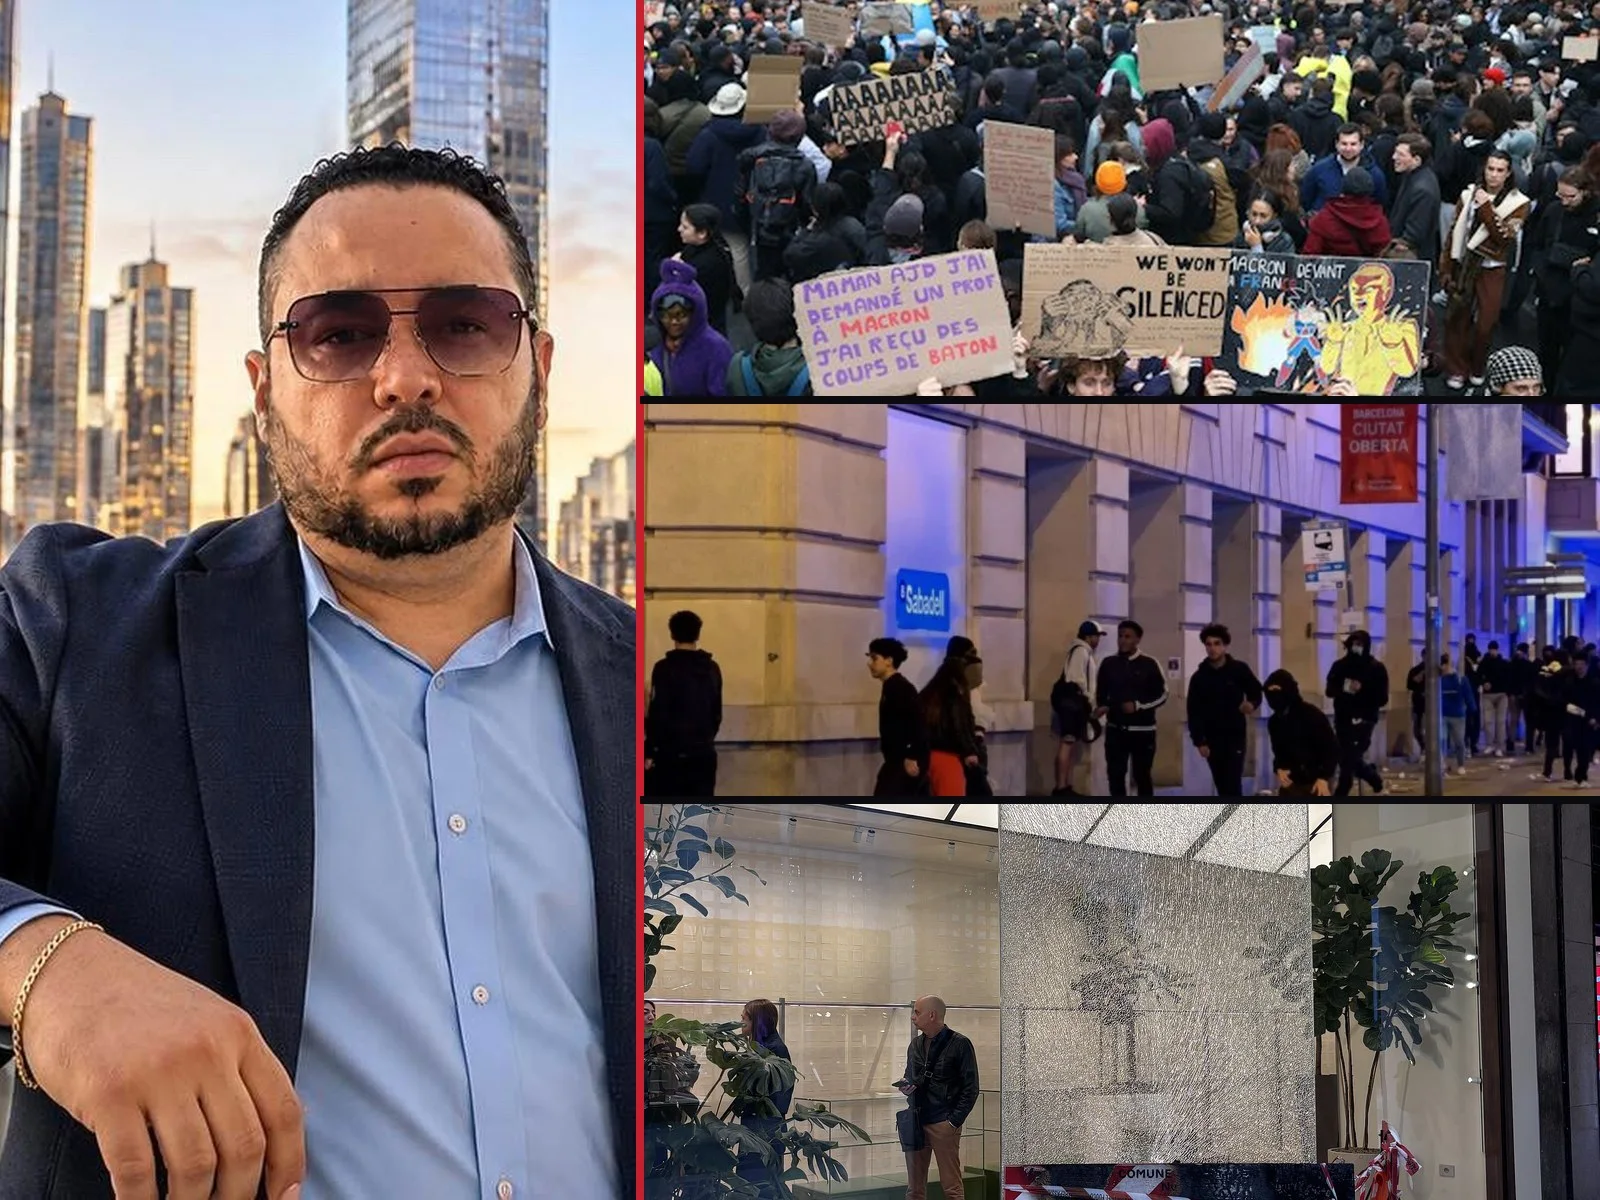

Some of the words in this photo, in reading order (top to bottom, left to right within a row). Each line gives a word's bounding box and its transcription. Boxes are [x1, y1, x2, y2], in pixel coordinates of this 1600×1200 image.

[1136, 254, 1168, 271] WE
[1296, 263, 1345, 279] DEVANT
[803, 271, 881, 304] MAMAN
[891, 262, 936, 284] AJD
[947, 253, 986, 275] J'AI
[1166, 272, 1186, 287] BE
[807, 286, 903, 326] DEMANDÉ
[914, 285, 944, 304] UN
[952, 274, 995, 296] PROF
[1115, 286, 1225, 319] SILENCED
[839, 306, 930, 338] MACRON
[816, 343, 862, 367] J'AI
[869, 328, 926, 354] REÇU
[937, 317, 979, 340] DES
[822, 358, 888, 387] COUPS
[896, 353, 920, 371] DE
[928, 335, 997, 365] BATON
[1352, 408, 1405, 419] BARCELONA
[1352, 421, 1404, 436] CIUTAT
[1348, 438, 1409, 453] OBERTA
[906, 584, 944, 616] Sabadell
[1118, 1168, 1173, 1179] COMUNE
